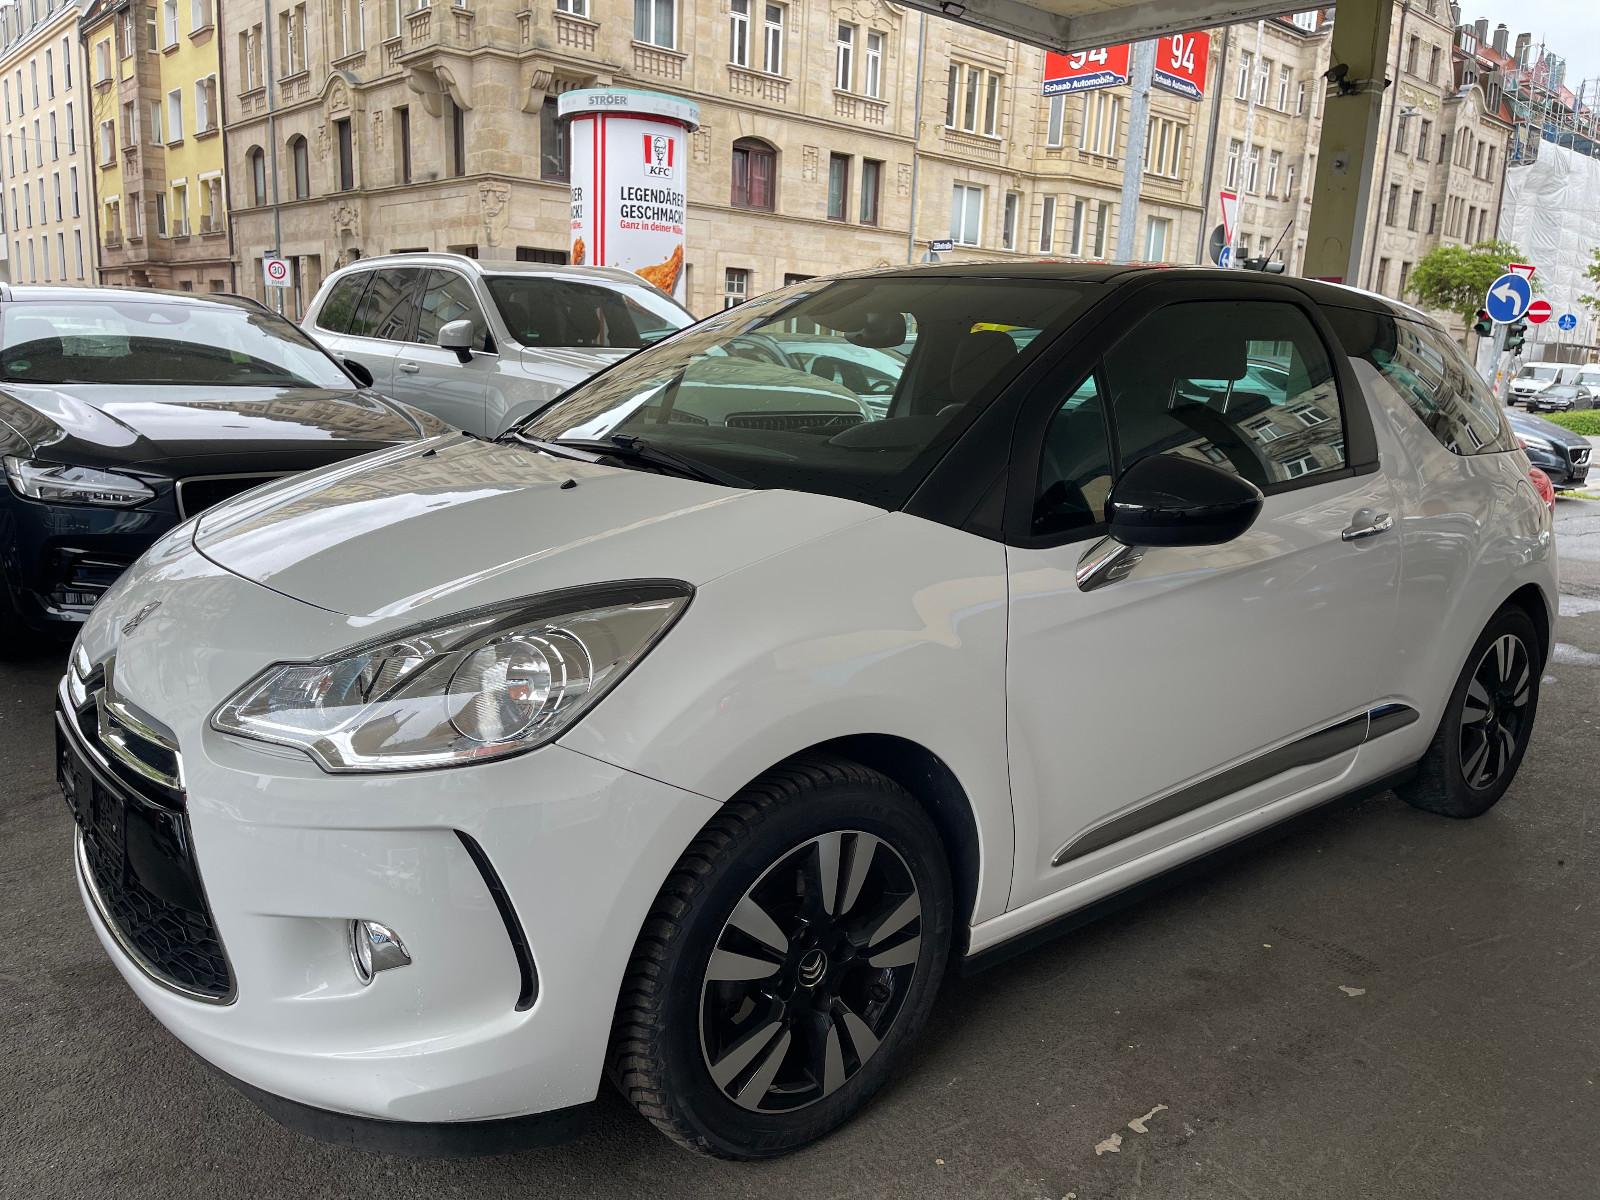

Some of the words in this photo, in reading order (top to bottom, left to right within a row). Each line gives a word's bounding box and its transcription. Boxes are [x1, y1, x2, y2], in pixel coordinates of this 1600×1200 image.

[1171, 33, 1195, 75] 94
[1044, 82, 1071, 92] Schaab
[1072, 75, 1114, 89] Automobile
[1155, 73, 1171, 87] Schaab
[588, 94, 627, 105] STRÖER
[649, 166, 670, 177] KFC
[620, 186, 684, 208] LEGENDÄRER
[620, 219, 640, 230] Ganz
[642, 220, 649, 231] in
[651, 221, 671, 233] deiner
[272, 266, 283, 275] 30
